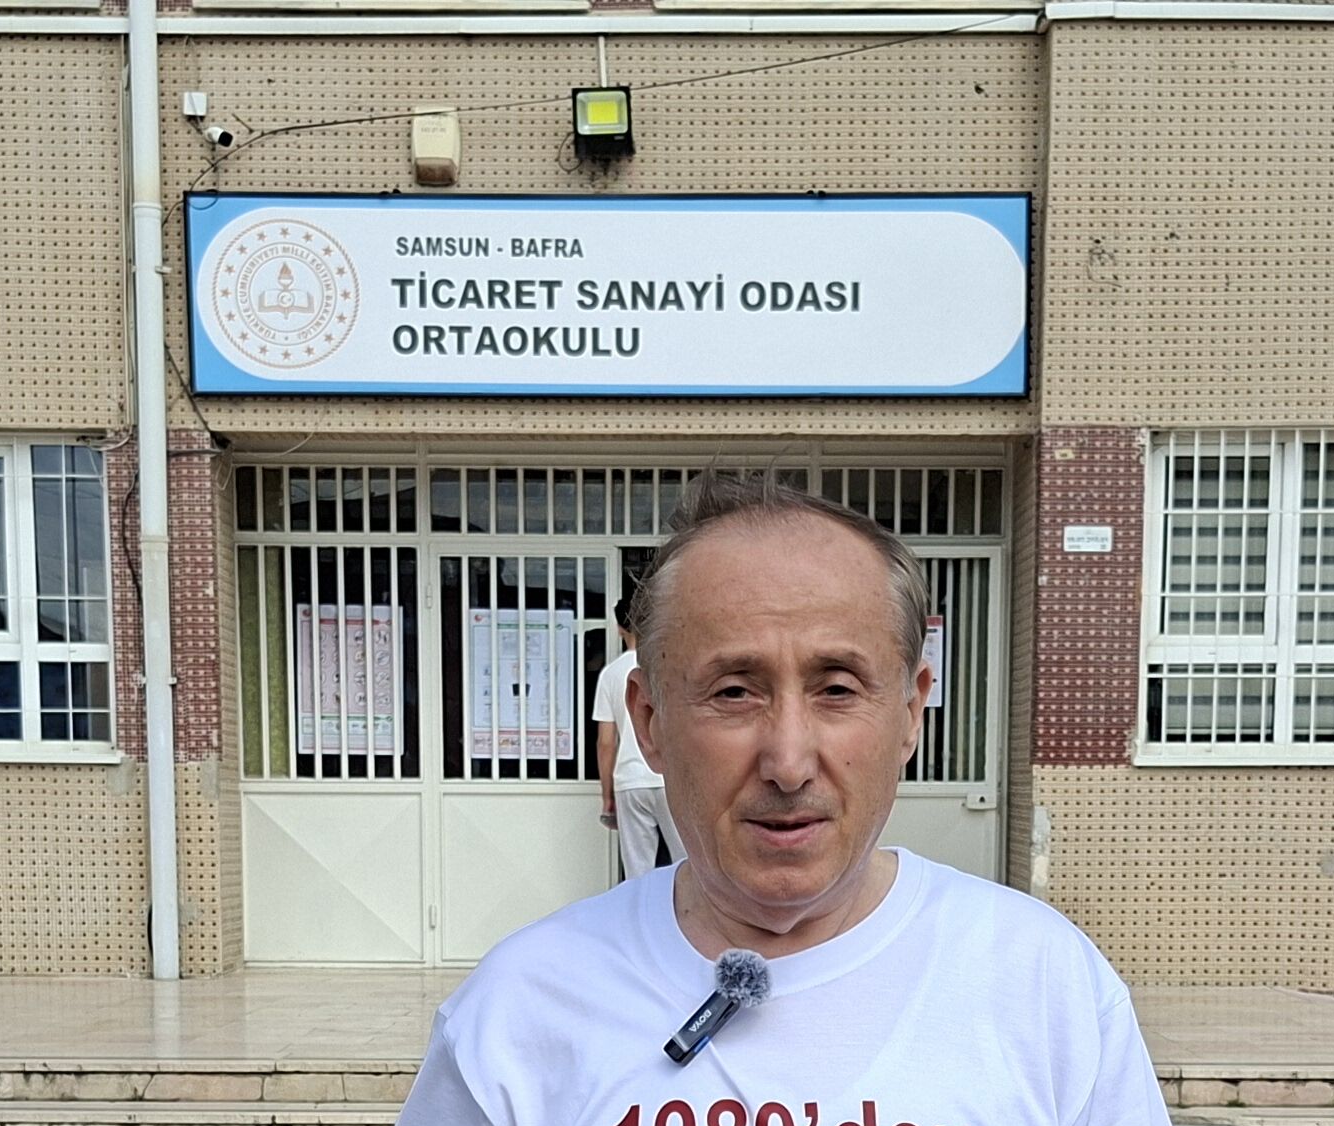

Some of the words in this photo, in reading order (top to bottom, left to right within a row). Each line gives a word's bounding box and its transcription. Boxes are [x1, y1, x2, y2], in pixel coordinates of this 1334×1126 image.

[395, 236, 489, 257] SAMSUN
[510, 237, 584, 258] BAFRA
[390, 271, 563, 310] TİCARET
[576, 273, 725, 311] SANAYİ
[739, 281, 861, 312] ODASI
[392, 324, 640, 357] ORTAOKULU
